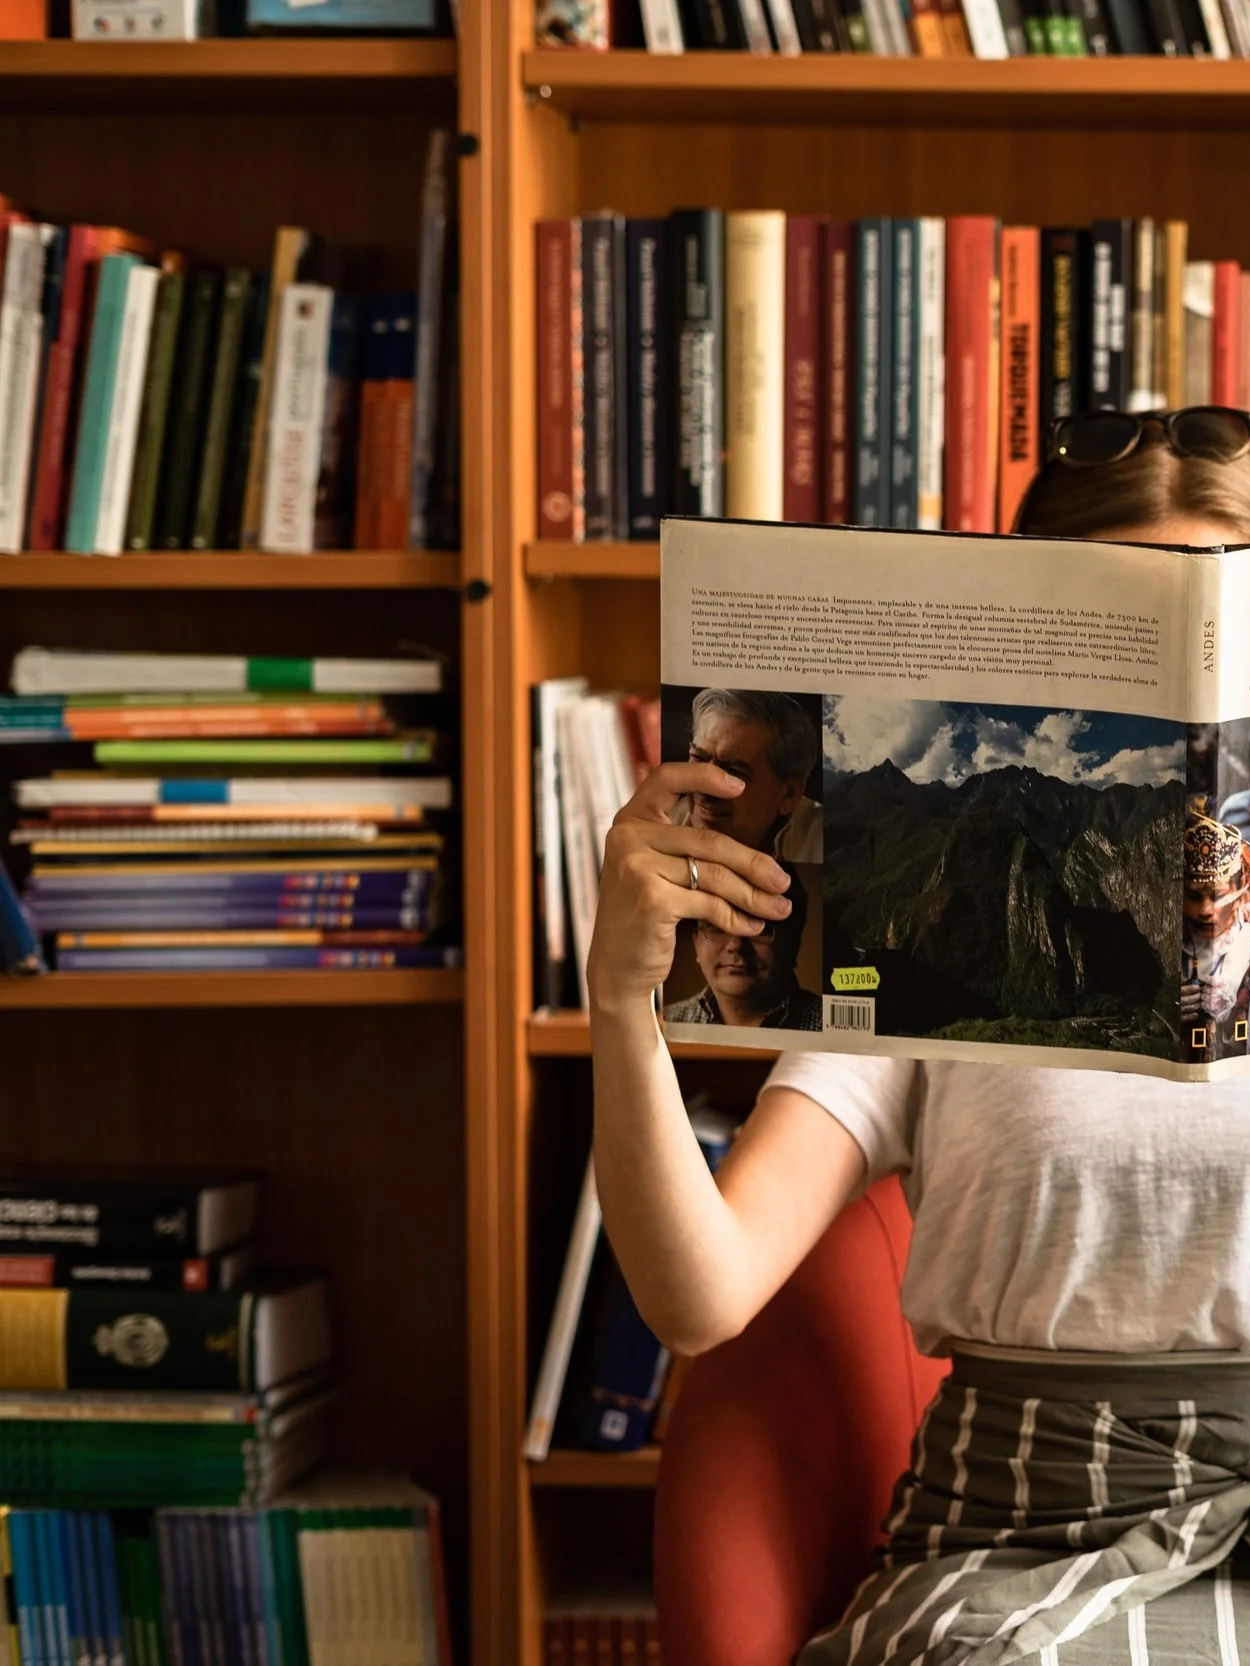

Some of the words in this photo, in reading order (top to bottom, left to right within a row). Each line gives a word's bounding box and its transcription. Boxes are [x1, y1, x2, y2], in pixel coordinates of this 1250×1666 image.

[691, 608, 718, 616] culturas
[730, 610, 762, 619] cauteloso
[764, 613, 789, 623] respeto
[796, 614, 833, 623] ancestrales
[878, 618, 893, 626] Para
[895, 619, 920, 628] invocar
[959, 622, 968, 630] de
[1023, 626, 1032, 634] de
[1033, 626, 1042, 634] tal
[1044, 627, 1078, 639] magnitud
[1088, 630, 1112, 642] precisa
[1128, 634, 1158, 645] habilidad
[737, 600, 753, 608] eleva
[755, 601, 773, 609] hacia
[783, 602, 799, 611] cielo
[801, 604, 820, 612] desde
[831, 605, 864, 617] Patagonia
[866, 607, 883, 616] hasta
[922, 610, 944, 619] Forma
[954, 612, 982, 623] desigual
[984, 613, 1015, 622] columna
[1016, 615, 1047, 624] vertebral
[1049, 617, 1058, 625] de
[1104, 621, 1133, 632] uniendo
[878, 598, 916, 610] implacable
[924, 600, 933, 608] de
[951, 602, 978, 610] intensa
[1018, 605, 1054, 614] cordillera
[1056, 607, 1065, 615] de
[1067, 608, 1077, 616] los
[1106, 611, 1115, 619] de
[1117, 614, 1136, 623] 7500
[1138, 614, 1149, 623] km
[1151, 616, 1159, 624] de
[692, 628, 703, 636] Las
[780, 633, 788, 641] de
[790, 633, 810, 642] Pablo
[811, 635, 834, 643] Corral
[836, 636, 852, 647] Vega
[854, 637, 891, 647] armonizan
[893, 639, 942, 652] perfectamente
[966, 643, 1000, 652] elocuente
[1002, 647, 1021, 656] prosa
[1023, 646, 1034, 654] del
[1035, 647, 1066, 656] novelista
[1068, 649, 1089, 658] Mario
[1090, 651, 1112, 663] Vargas
[1135, 655, 1158, 665] Ambos
[706, 639, 729, 648] nativos
[731, 640, 739, 648] de
[773, 643, 797, 651] andina
[812, 647, 824, 656] que
[826, 646, 853, 655] dedican
[866, 648, 900, 660] homenaje
[902, 650, 927, 659] sincero
[929, 651, 956, 663] cargado
[957, 653, 966, 661] de
[1005, 658, 1020, 666] muy
[711, 619, 752, 629] sensibilidad
[793, 626, 813, 635] pocos
[877, 628, 918, 638] cualificados
[920, 633, 933, 641] que
[935, 631, 945, 639] los
[946, 632, 959, 640] dos
[960, 633, 995, 642] talentosos
[997, 634, 1021, 643] artistas
[1022, 638, 1036, 647] que
[1037, 637, 1072, 647] realizaron
[1089, 640, 1138, 653] extraordinario
[1203, 620, 1214, 673] ANDES
[692, 648, 700, 656] Es
[712, 649, 737, 661] trabajo
[748, 651, 780, 663] profunda
[787, 653, 827, 666] excepcional
[828, 656, 852, 665] belleza
[853, 660, 866, 668] que
[868, 658, 903, 667] trasciende
[912, 660, 969, 674] espectacularidad
[976, 664, 986, 672] los
[988, 664, 1013, 673] colores
[1044, 670, 1059, 679] para
[1061, 669, 1090, 681] explorar
[1099, 672, 1131, 683] verdadera
[1133, 675, 1148, 685] alma
[1150, 677, 1158, 686] de
[700, 658, 733, 668] cordillera
[734, 660, 743, 668] de
[744, 661, 754, 669] los
[756, 662, 777, 670] Andes
[784, 663, 792, 671] de
[794, 664, 800, 672] la
[802, 666, 821, 675] gente
[822, 668, 835, 676] que
[837, 666, 843, 674] la
